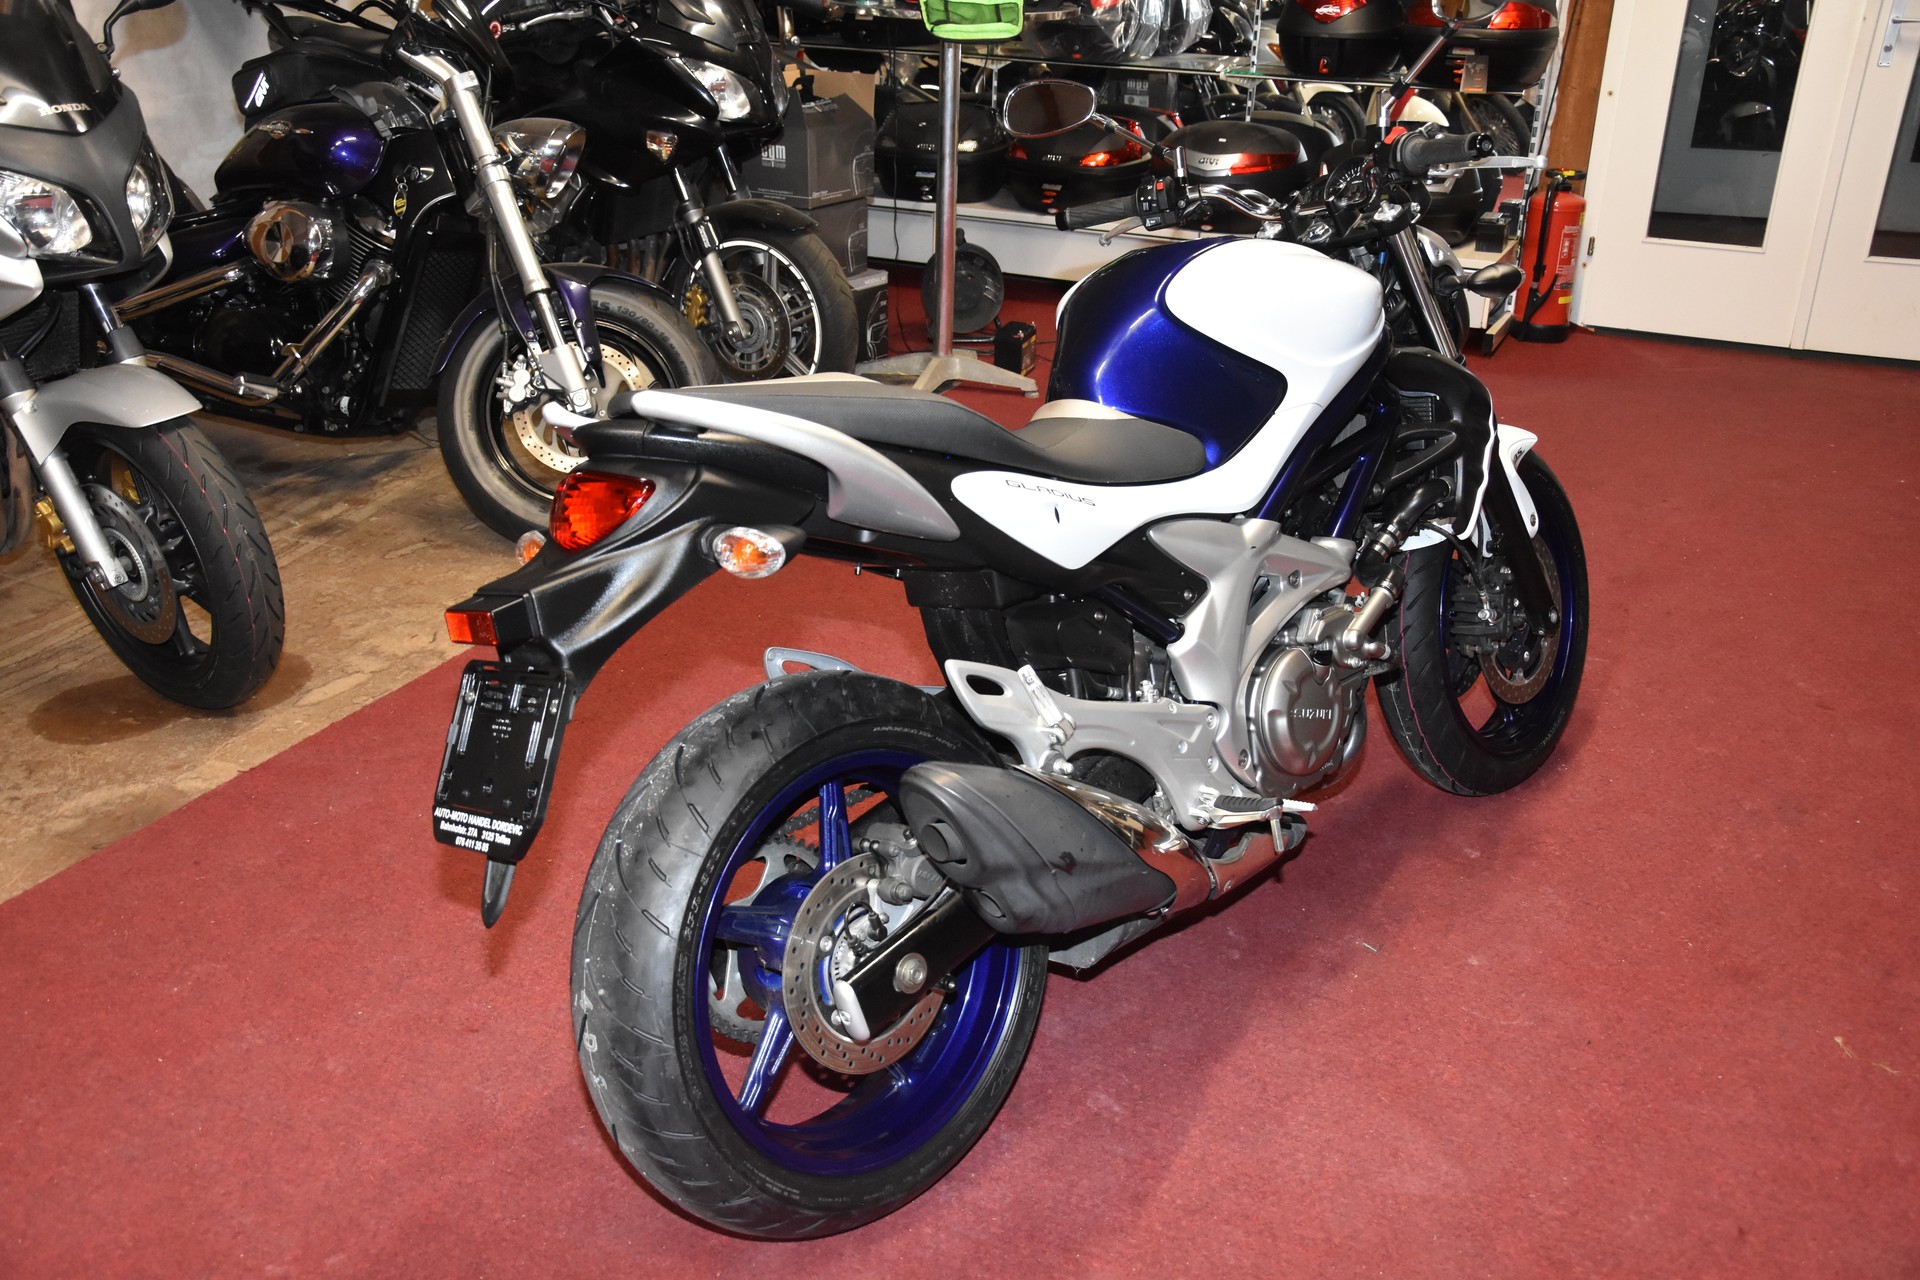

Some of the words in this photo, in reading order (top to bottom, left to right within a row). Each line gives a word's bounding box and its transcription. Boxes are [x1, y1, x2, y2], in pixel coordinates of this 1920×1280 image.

[38, 103, 92, 117] HONDA
[1198, 157, 1220, 166] GIVI
[1005, 479, 1096, 506] GLADIUS
[1291, 708, 1332, 719] SUZUKI
[433, 806, 468, 822] AUTO-MOTO
[468, 814, 491, 829] HANDEL
[492, 819, 524, 836] DORDEVIC
[467, 826, 478, 838] 27A
[482, 830, 494, 842] 3125
